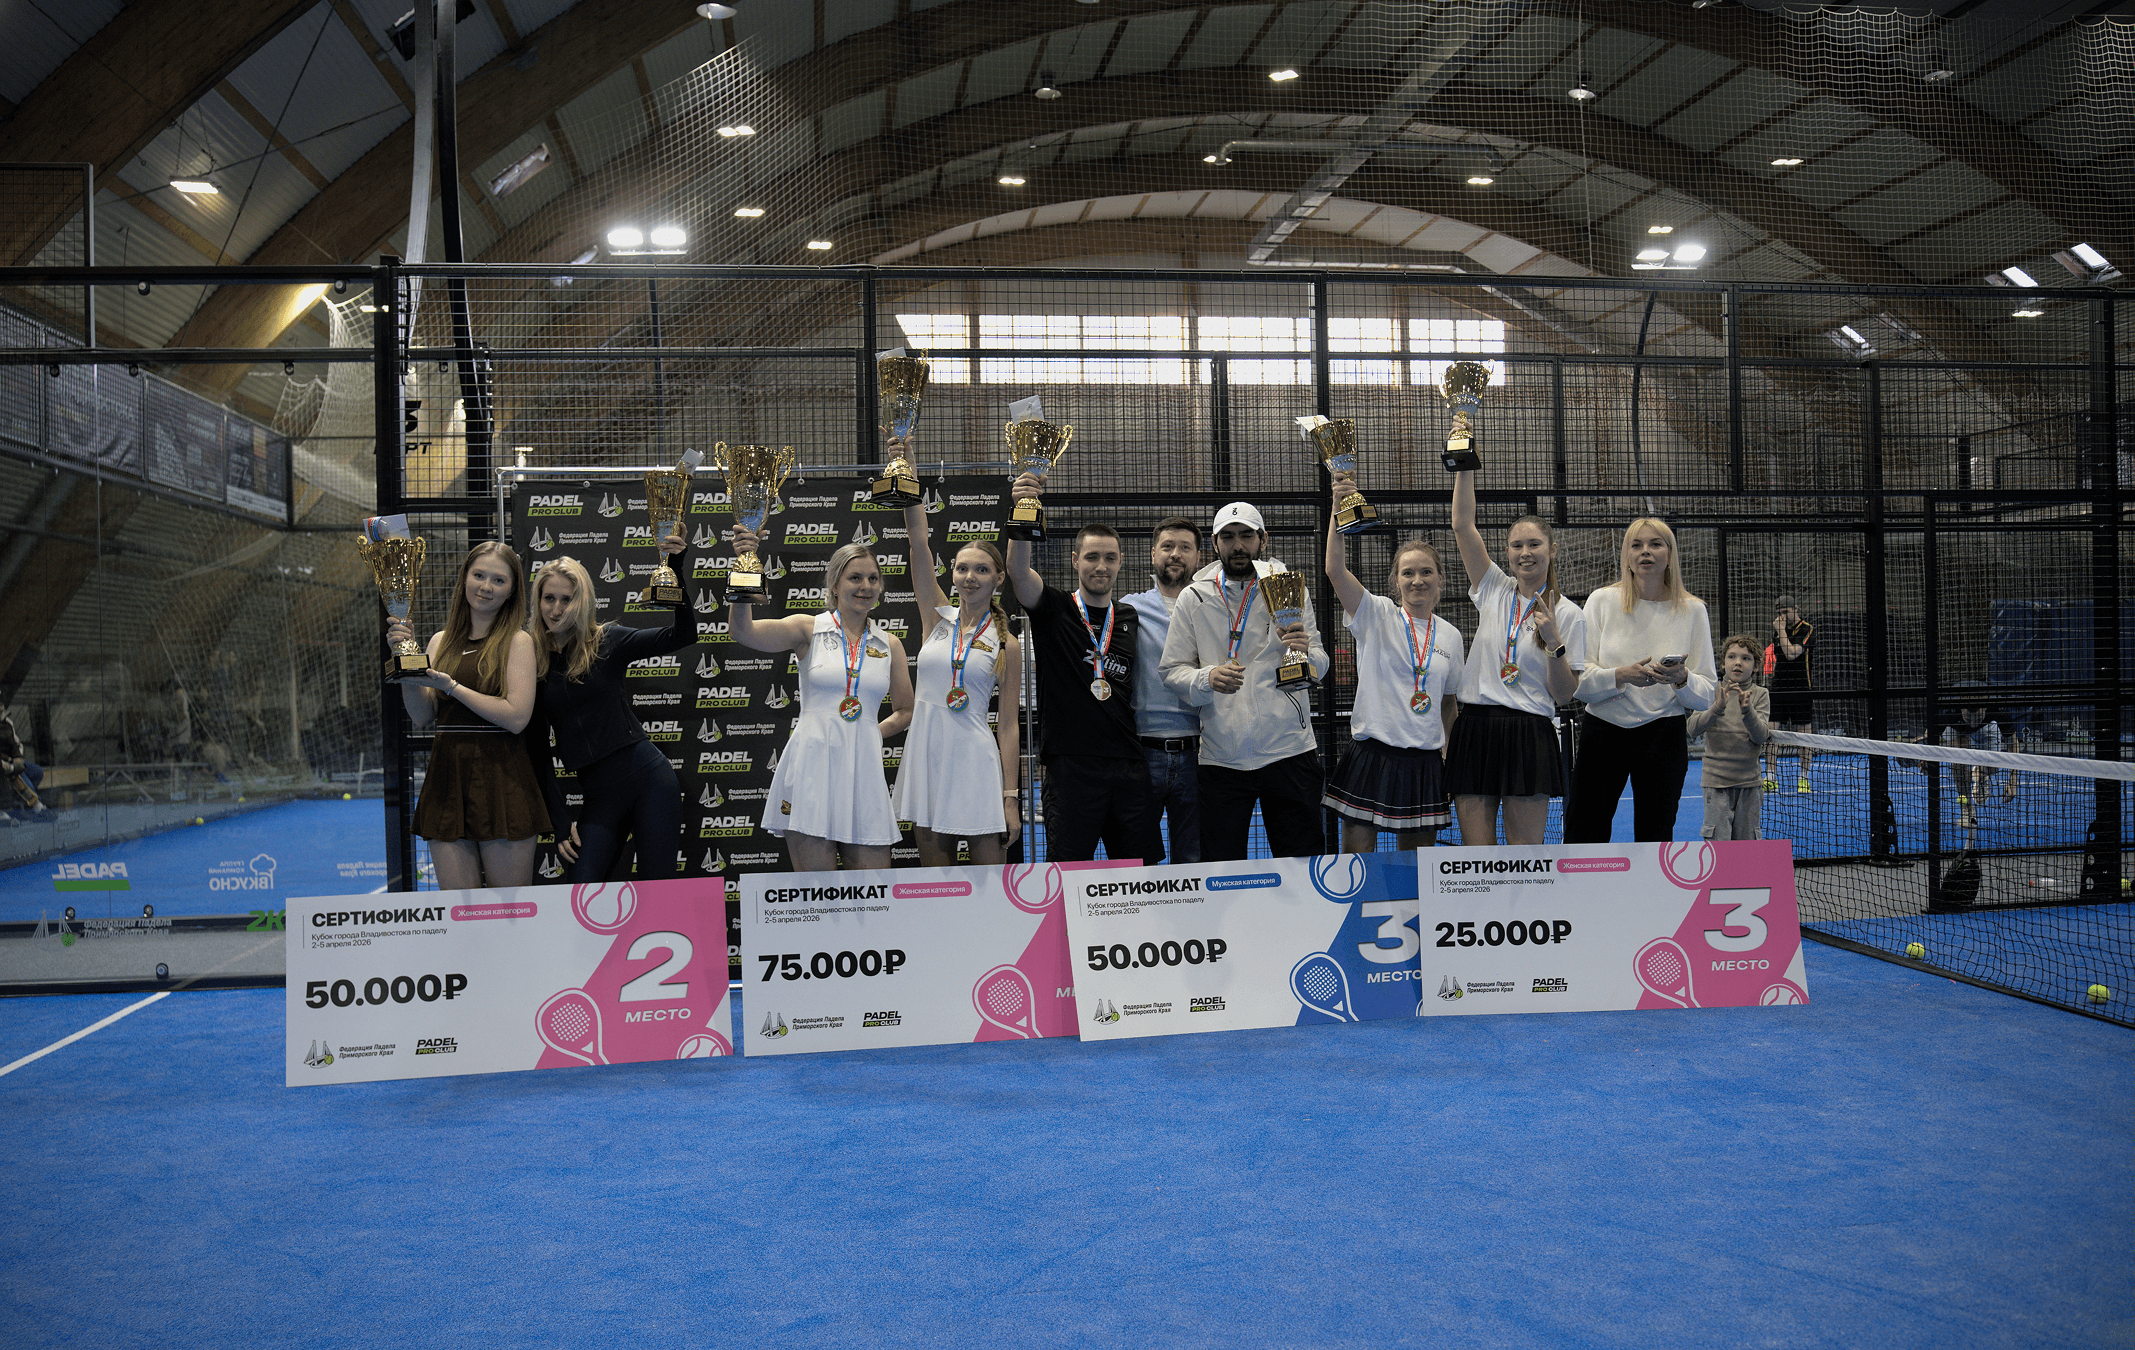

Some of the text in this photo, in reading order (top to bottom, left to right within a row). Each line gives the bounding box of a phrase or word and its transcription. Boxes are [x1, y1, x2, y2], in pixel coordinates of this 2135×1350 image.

[529, 495, 583, 506] PADEL
[786, 524, 838, 535] PADEL
[948, 522, 1000, 532] PADEL
[698, 687, 751, 698] PADEL
[700, 752, 753, 763] PADEL
[701, 816, 754, 828] PADEL
[1440, 859, 1553, 875] СЕРТИФИКАТ
[1086, 878, 1201, 897] СЕРТИФИКАТ
[1212, 878, 1276, 888] Мужская категория
[1481, 878, 1524, 886] Владивостока
[764, 885, 888, 903] СЕРТИФИКАТ
[312, 907, 446, 927] СЕРТИФИКАТ
[492, 908, 531, 916] категория
[84, 918, 173, 929] Федерация Падела
[1704, 888, 1772, 953] 3
[312, 933, 334, 941] Кубок
[334, 932, 360, 940] города
[360, 930, 411, 938] Владивостока
[1358, 899, 1420, 964] 3
[1435, 920, 1572, 948] 25.000₽
[326, 941, 352, 949] апреля
[352, 939, 372, 947] 2026
[1088, 938, 1227, 971] 50.000₽
[619, 930, 694, 1002] 2
[758, 949, 906, 982] 75.000₽
[1711, 960, 1770, 972] МЕСТО
[1367, 970, 1422, 983] МЕСТО
[1532, 978, 1568, 986] PADEL
[306, 974, 468, 1009] 50.000₽
[1190, 996, 1226, 1006] PADEL
[625, 1008, 691, 1023] МЕСТО
[864, 1010, 902, 1020] PADEL
[417, 1038, 458, 1048] PADEL
[339, 1051, 378, 1059] Приморского
